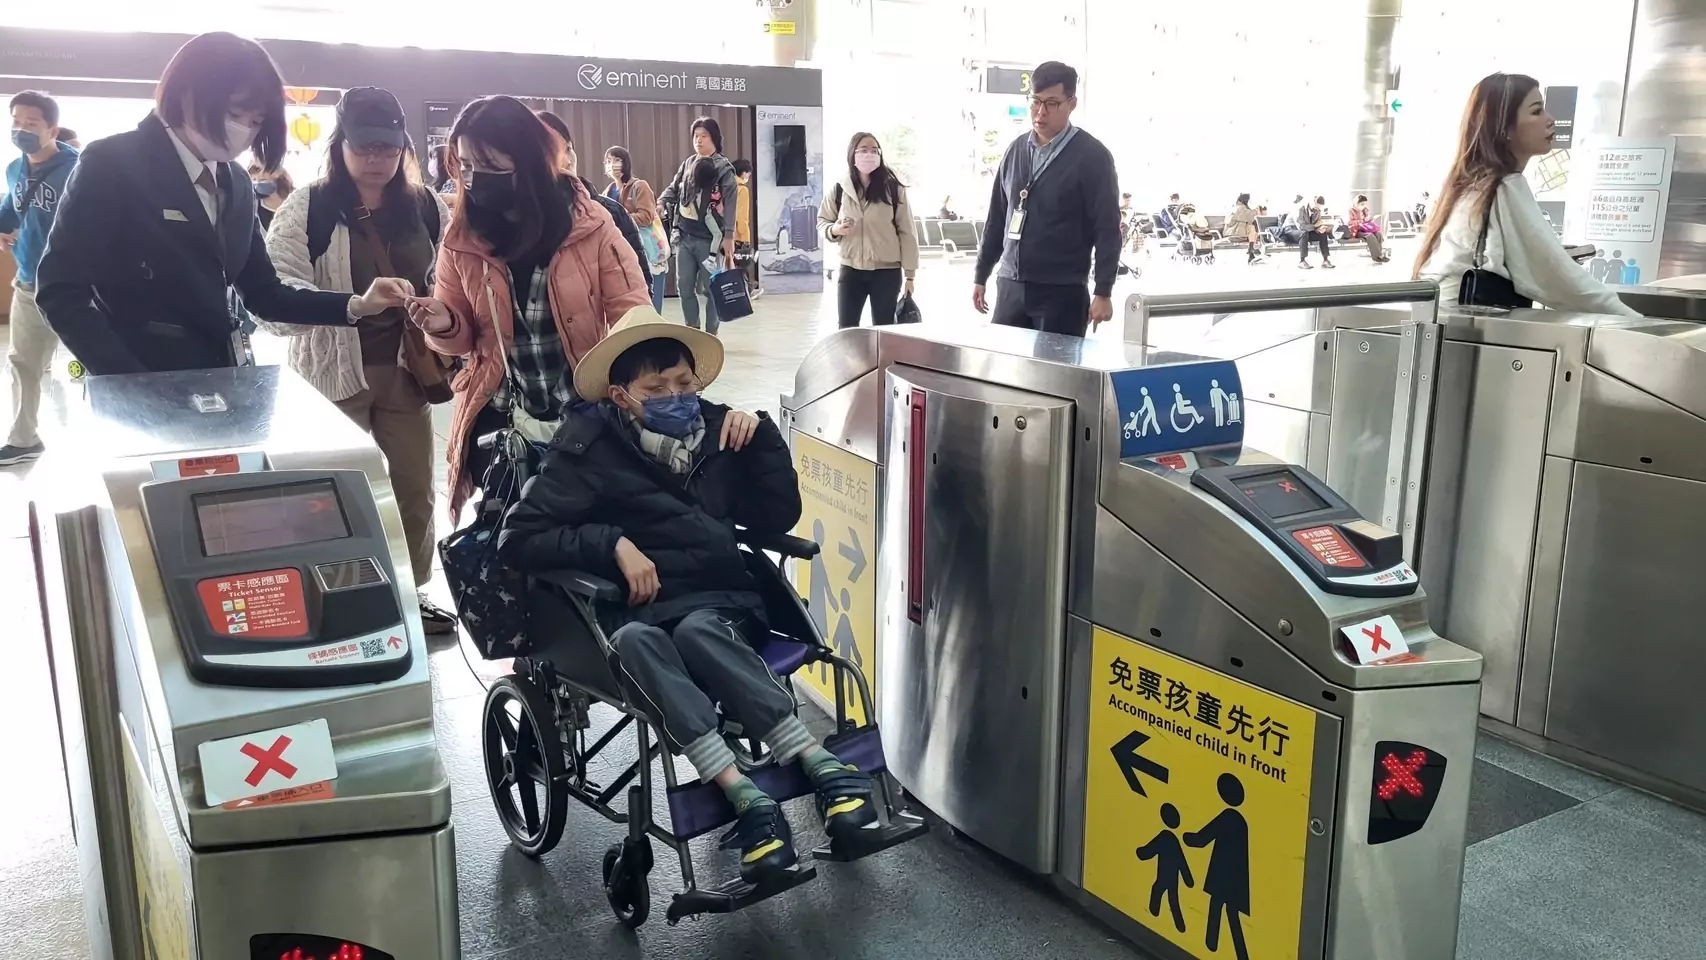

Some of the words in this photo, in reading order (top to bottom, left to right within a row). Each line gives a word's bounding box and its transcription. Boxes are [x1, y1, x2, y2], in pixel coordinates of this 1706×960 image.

[606, 69, 687, 89] eminent
[695, 76, 746, 92] 萬國通路
[1020, 72, 1030, 92] 3
[767, 112, 796, 120] eminent
[800, 453, 868, 506] 免票孩童先行
[801, 481, 833, 506] Accompanied
[833, 499, 847, 514] child
[854, 507, 868, 525] front
[217, 574, 289, 592] 票卡感應區
[229, 590, 254, 598] Ticket
[255, 586, 282, 594] Sensor
[1108, 656, 1290, 757] 免票孩童先行
[1108, 694, 1192, 741] Accompanied
[1195, 733, 1229, 757] child
[1233, 746, 1247, 765] in
[1250, 754, 1288, 783] front
